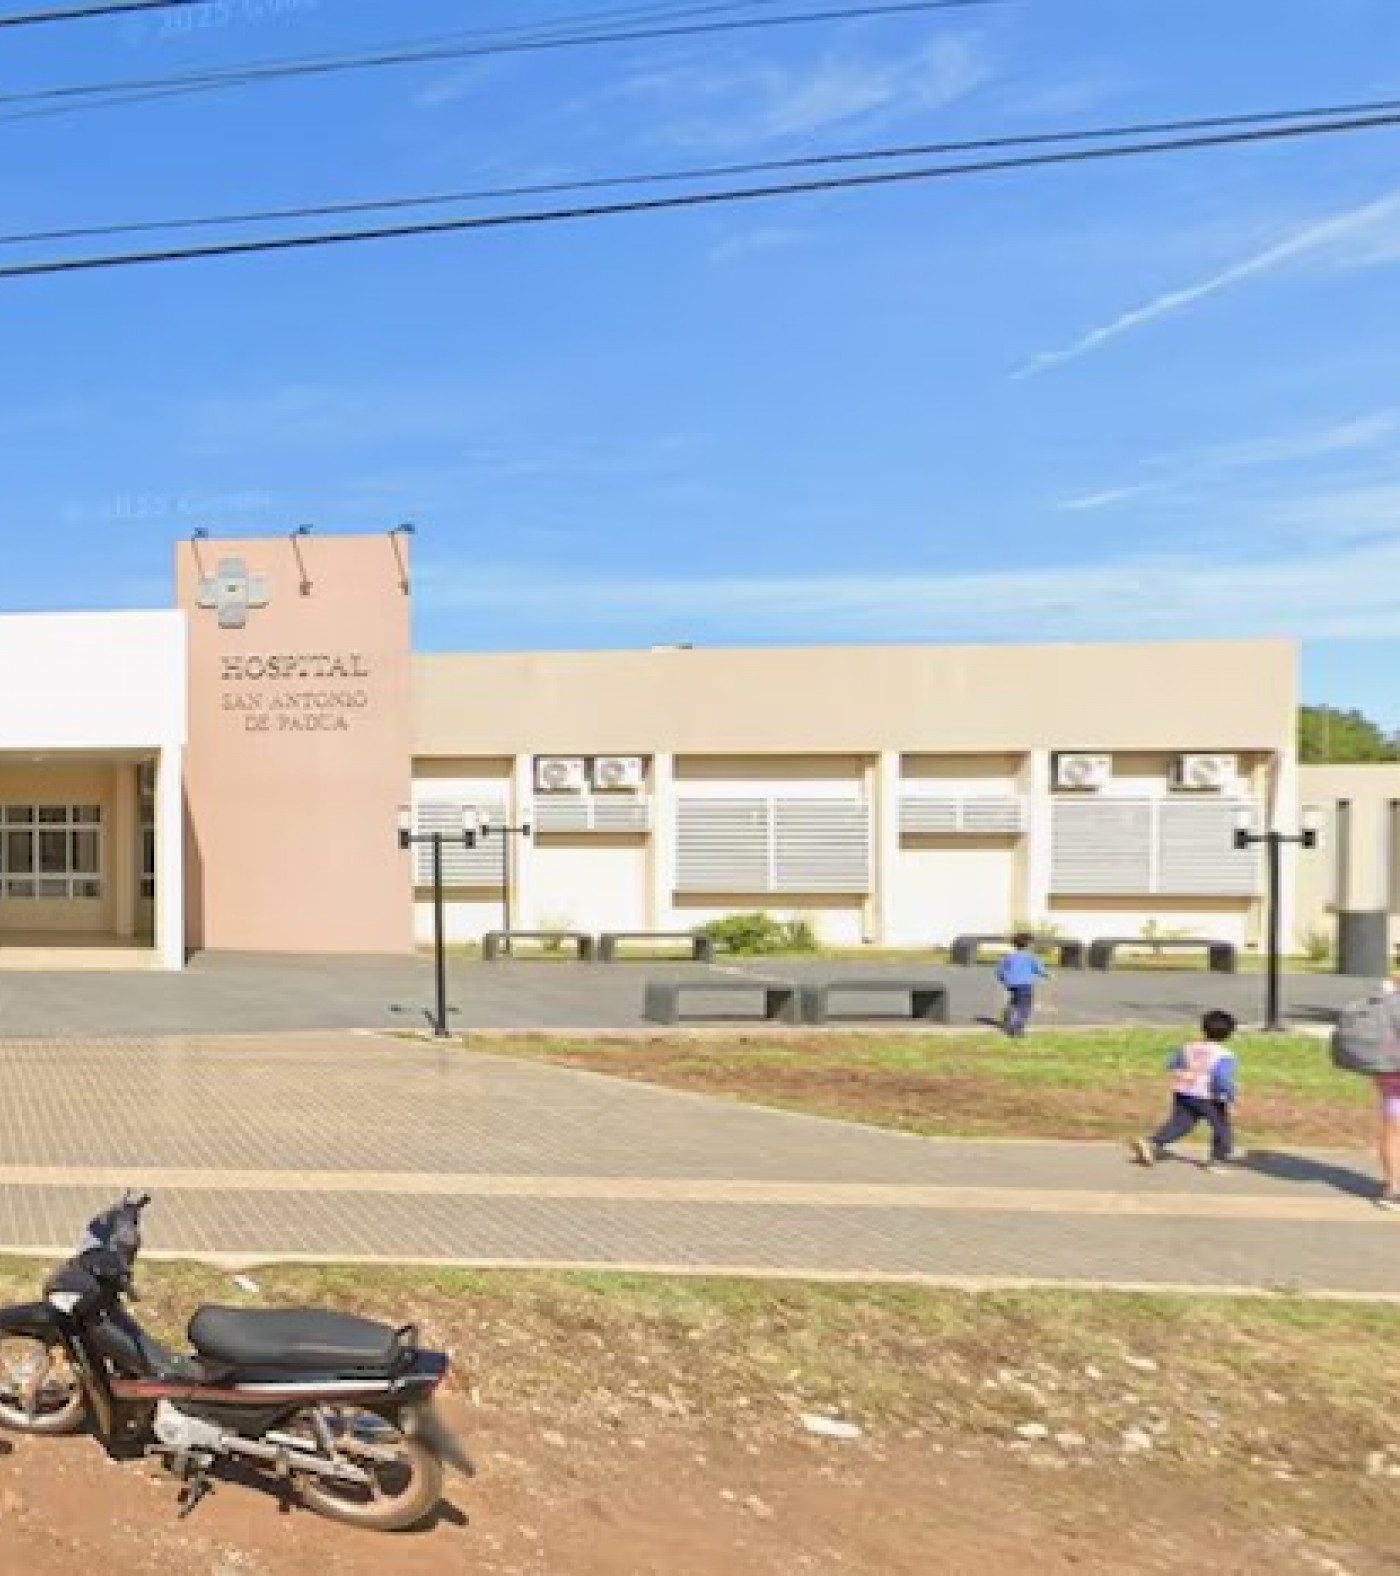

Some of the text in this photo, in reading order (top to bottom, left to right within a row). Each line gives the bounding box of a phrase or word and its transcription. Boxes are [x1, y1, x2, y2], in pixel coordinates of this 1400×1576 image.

[220, 653, 369, 680] HOSPITAL
[221, 690, 369, 711] SAN ANTONIO
[244, 712, 349, 731] DE PADUA
